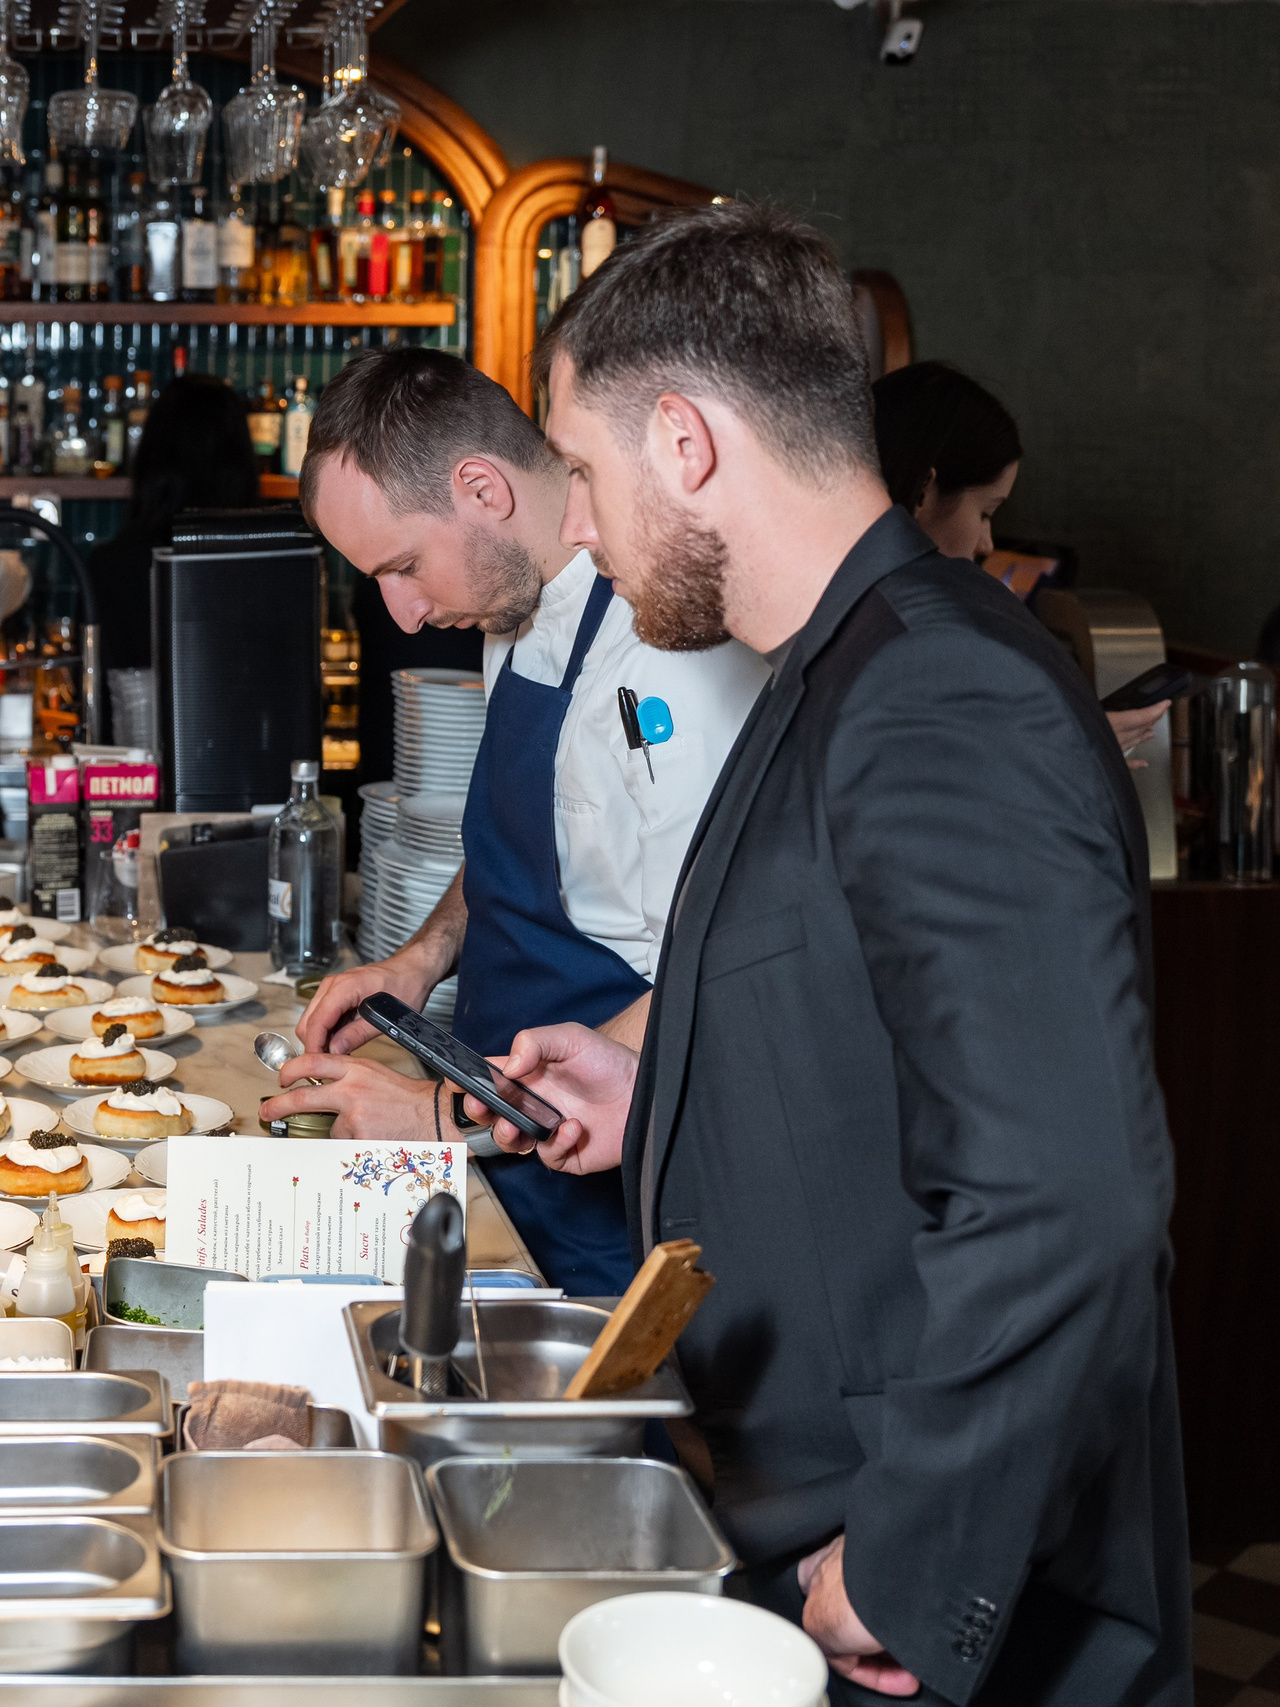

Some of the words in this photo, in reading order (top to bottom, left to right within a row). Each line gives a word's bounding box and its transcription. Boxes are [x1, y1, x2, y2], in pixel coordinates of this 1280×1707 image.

[89, 776, 155, 796] ПЕТМОЛ
[90, 821, 113, 843] 33
[197, 1199, 207, 1236] Salades
[300, 1245, 309, 1270] Plats
[360, 1233, 369, 1260] Sucré
